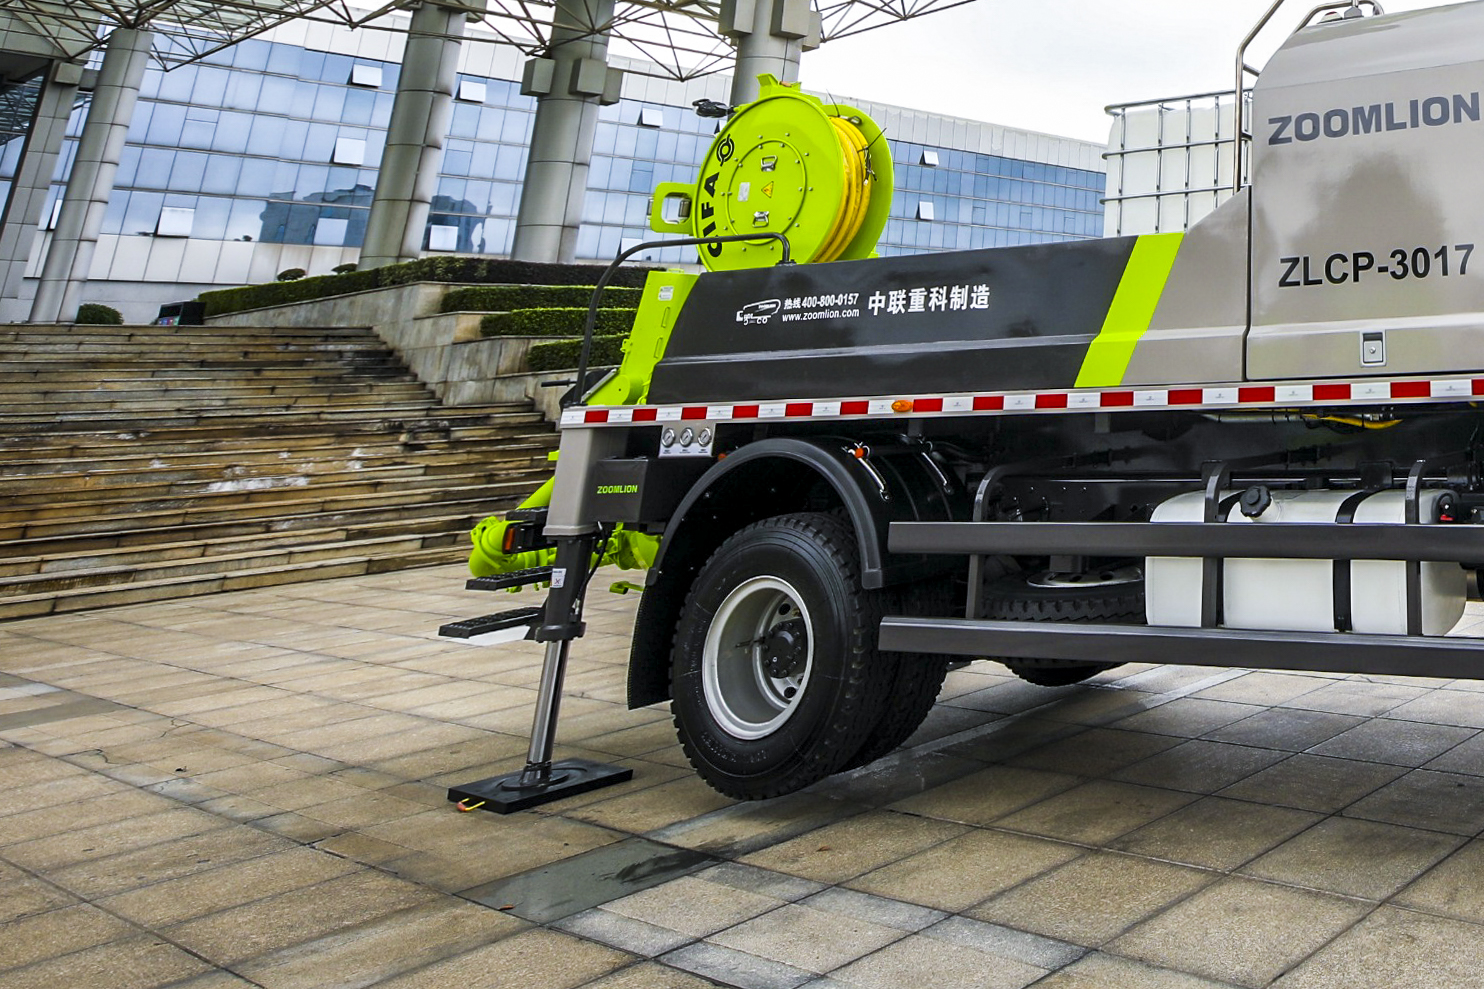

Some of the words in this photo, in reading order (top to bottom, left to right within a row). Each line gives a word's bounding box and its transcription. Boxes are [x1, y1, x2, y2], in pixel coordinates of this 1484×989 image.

[1267, 91, 1481, 146] ZOOMLION
[701, 171, 722, 258] CIFA
[1278, 244, 1475, 287] ZLCP-3017
[781, 307, 860, 322] www.zoomlion.com
[783, 297, 801, 310] 热线
[801, 292, 860, 309] 400-800-0157
[867, 283, 991, 317] 中联重科制造
[597, 484, 638, 494] ZOOMLION
